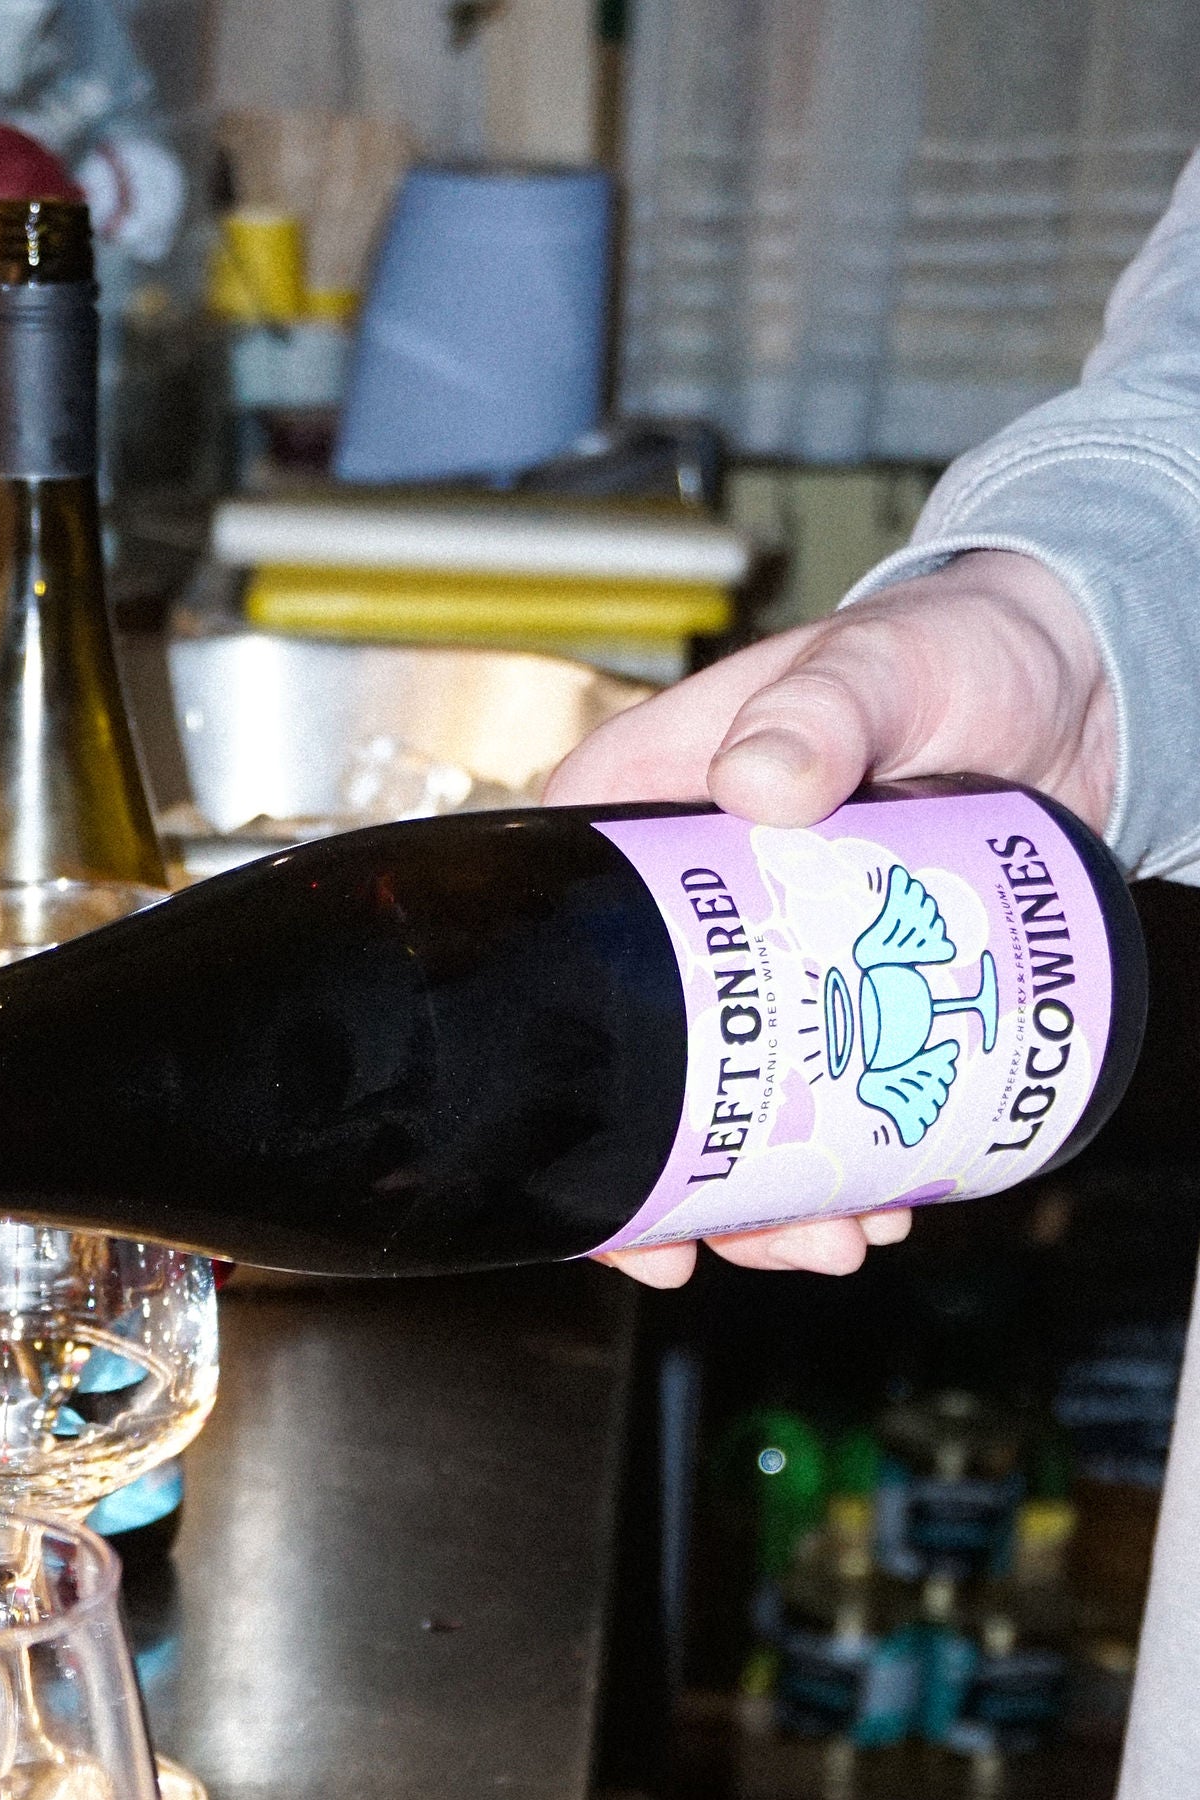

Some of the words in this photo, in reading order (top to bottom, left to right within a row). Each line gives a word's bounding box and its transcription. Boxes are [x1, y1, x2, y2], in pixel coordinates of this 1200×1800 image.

[680, 868, 751, 956] RED
[994, 883, 1015, 923] PLUMS
[754, 935, 773, 982] WINE
[1009, 927, 1024, 969] FRESH
[1016, 972, 1026, 983] &
[714, 968, 762, 1046] ON
[766, 992, 777, 1028] RED
[985, 835, 1076, 1156] LOCOWINES
[1016, 988, 1027, 1042] CHERRY
[758, 1038, 778, 1123] ORGANIC
[992, 1044, 1023, 1123] RASPBERRY,
[686, 1057, 761, 1185] LEFT
